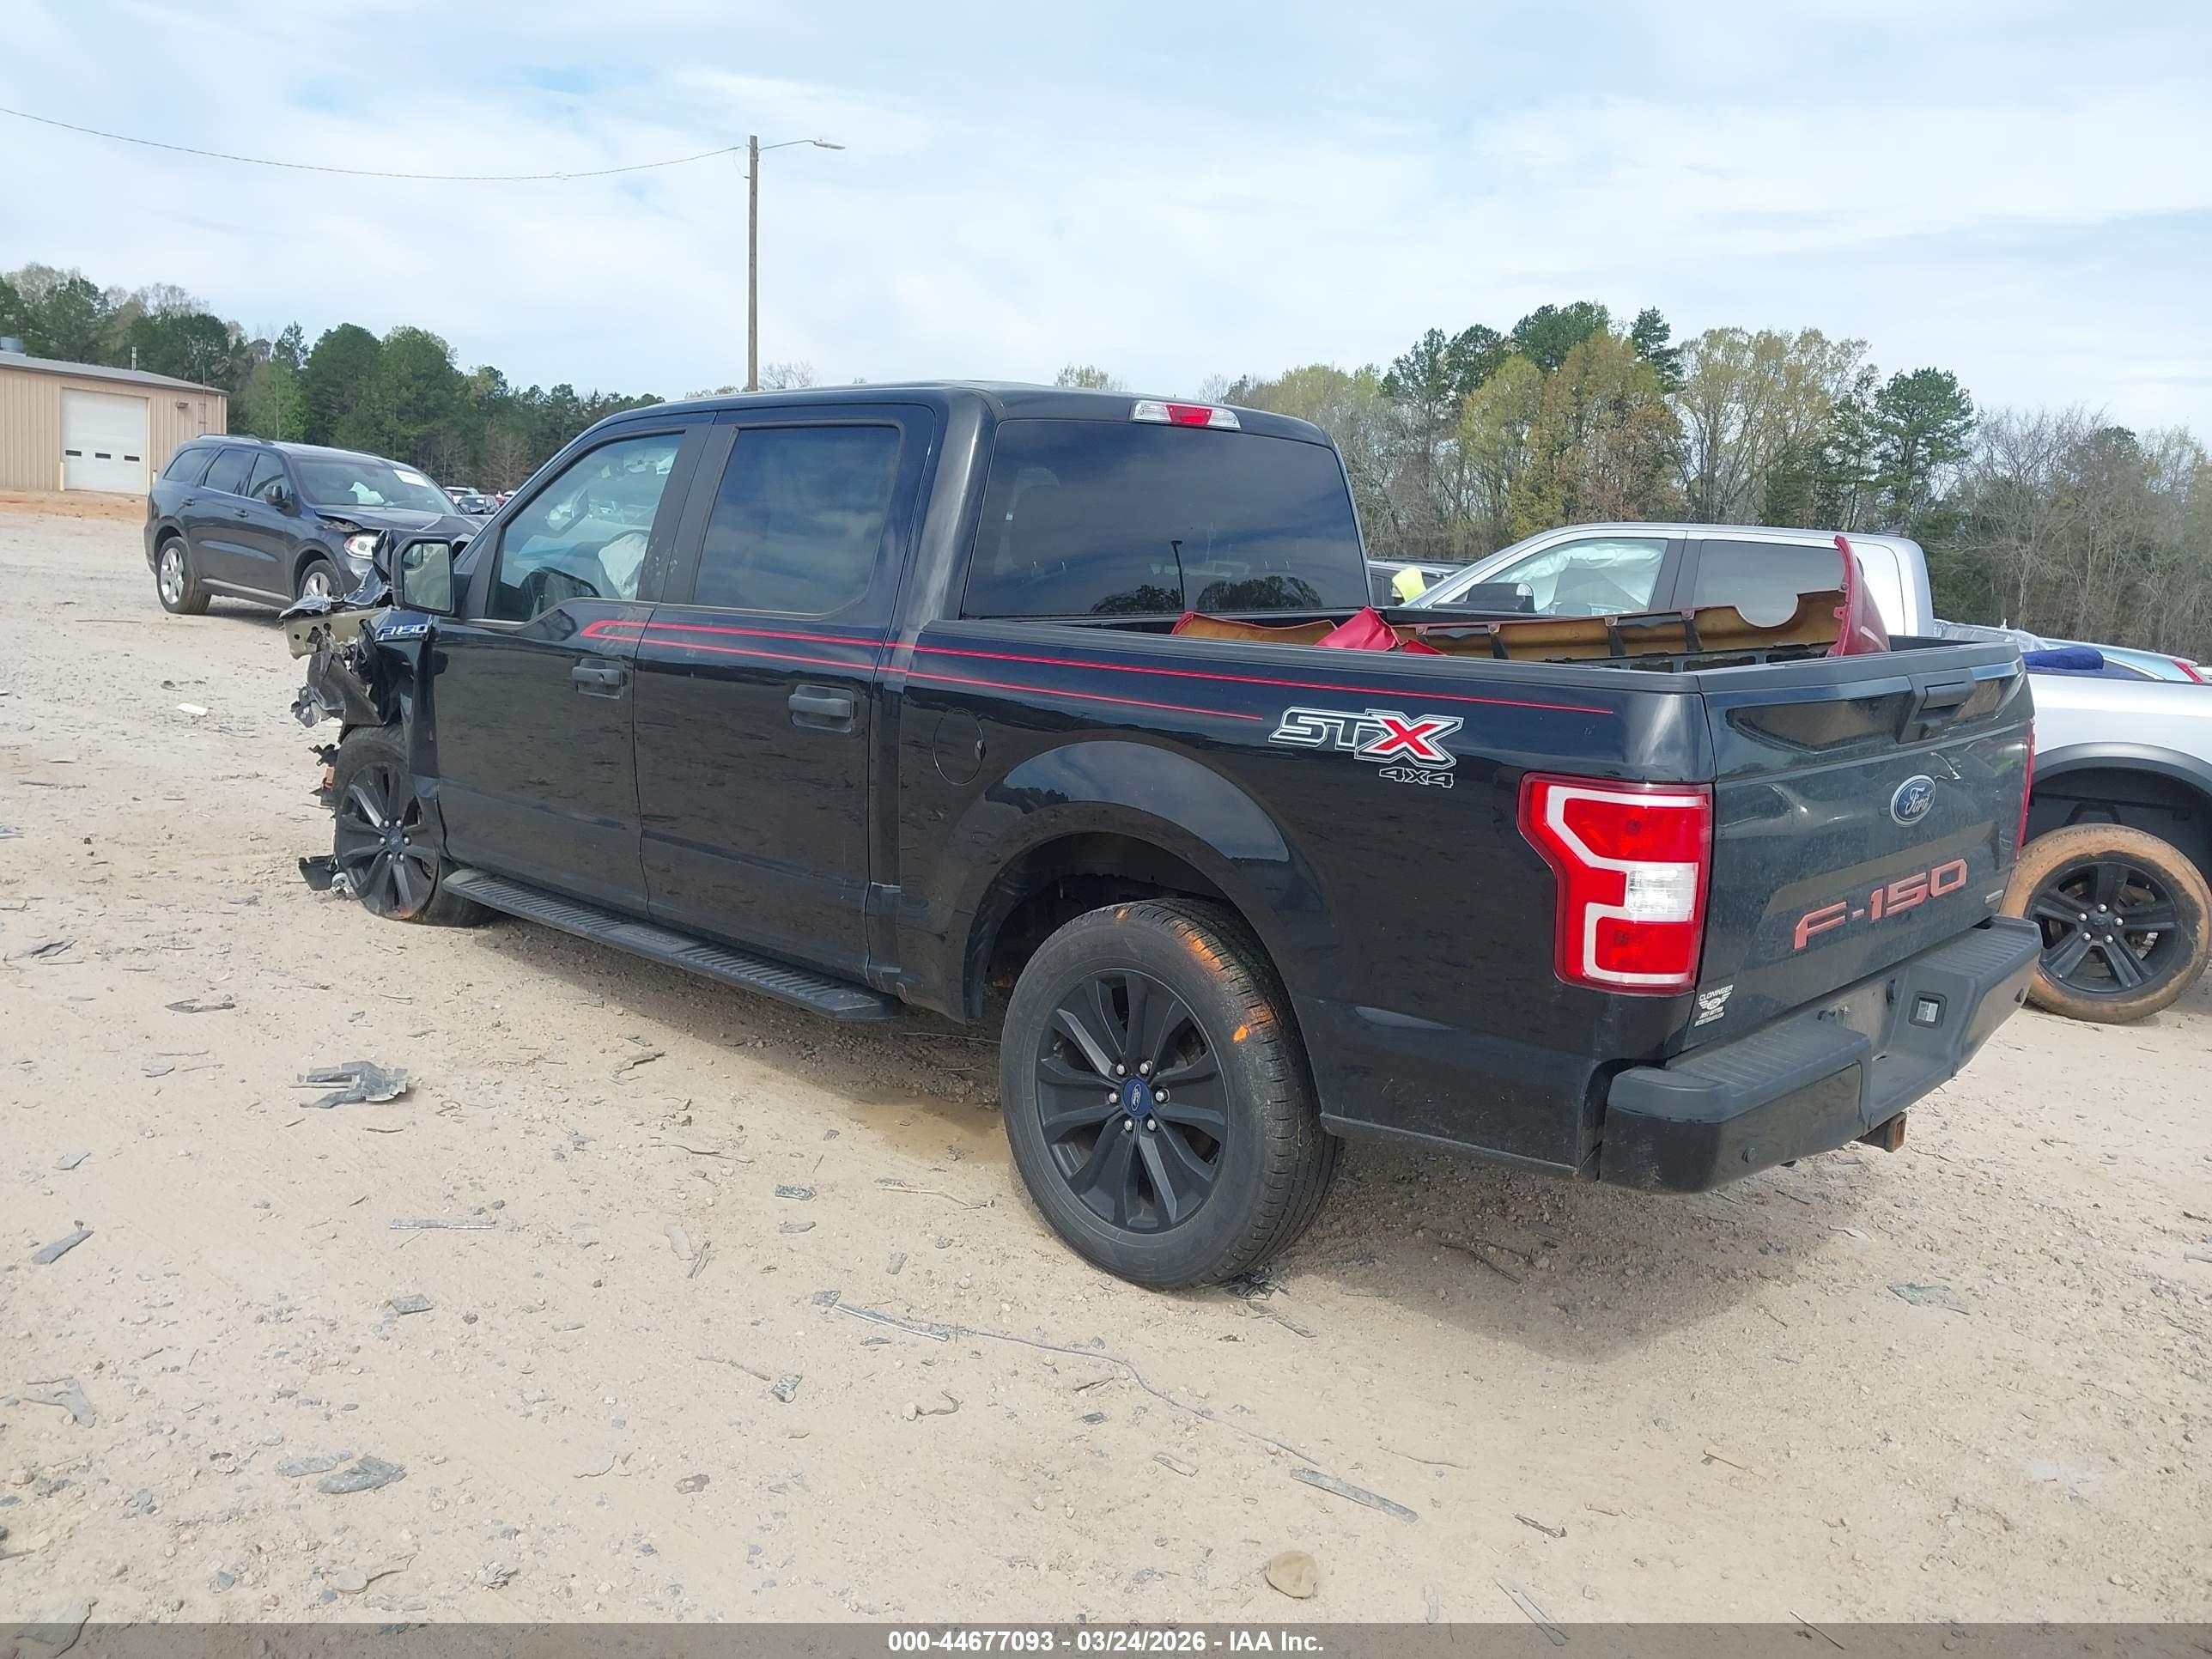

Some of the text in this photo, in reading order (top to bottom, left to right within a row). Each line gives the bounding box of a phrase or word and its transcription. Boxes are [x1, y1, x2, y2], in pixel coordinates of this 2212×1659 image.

[1268, 707, 1464, 768] STX
[1905, 786, 1933, 815] Ford
[1793, 858, 1967, 950] F-150
